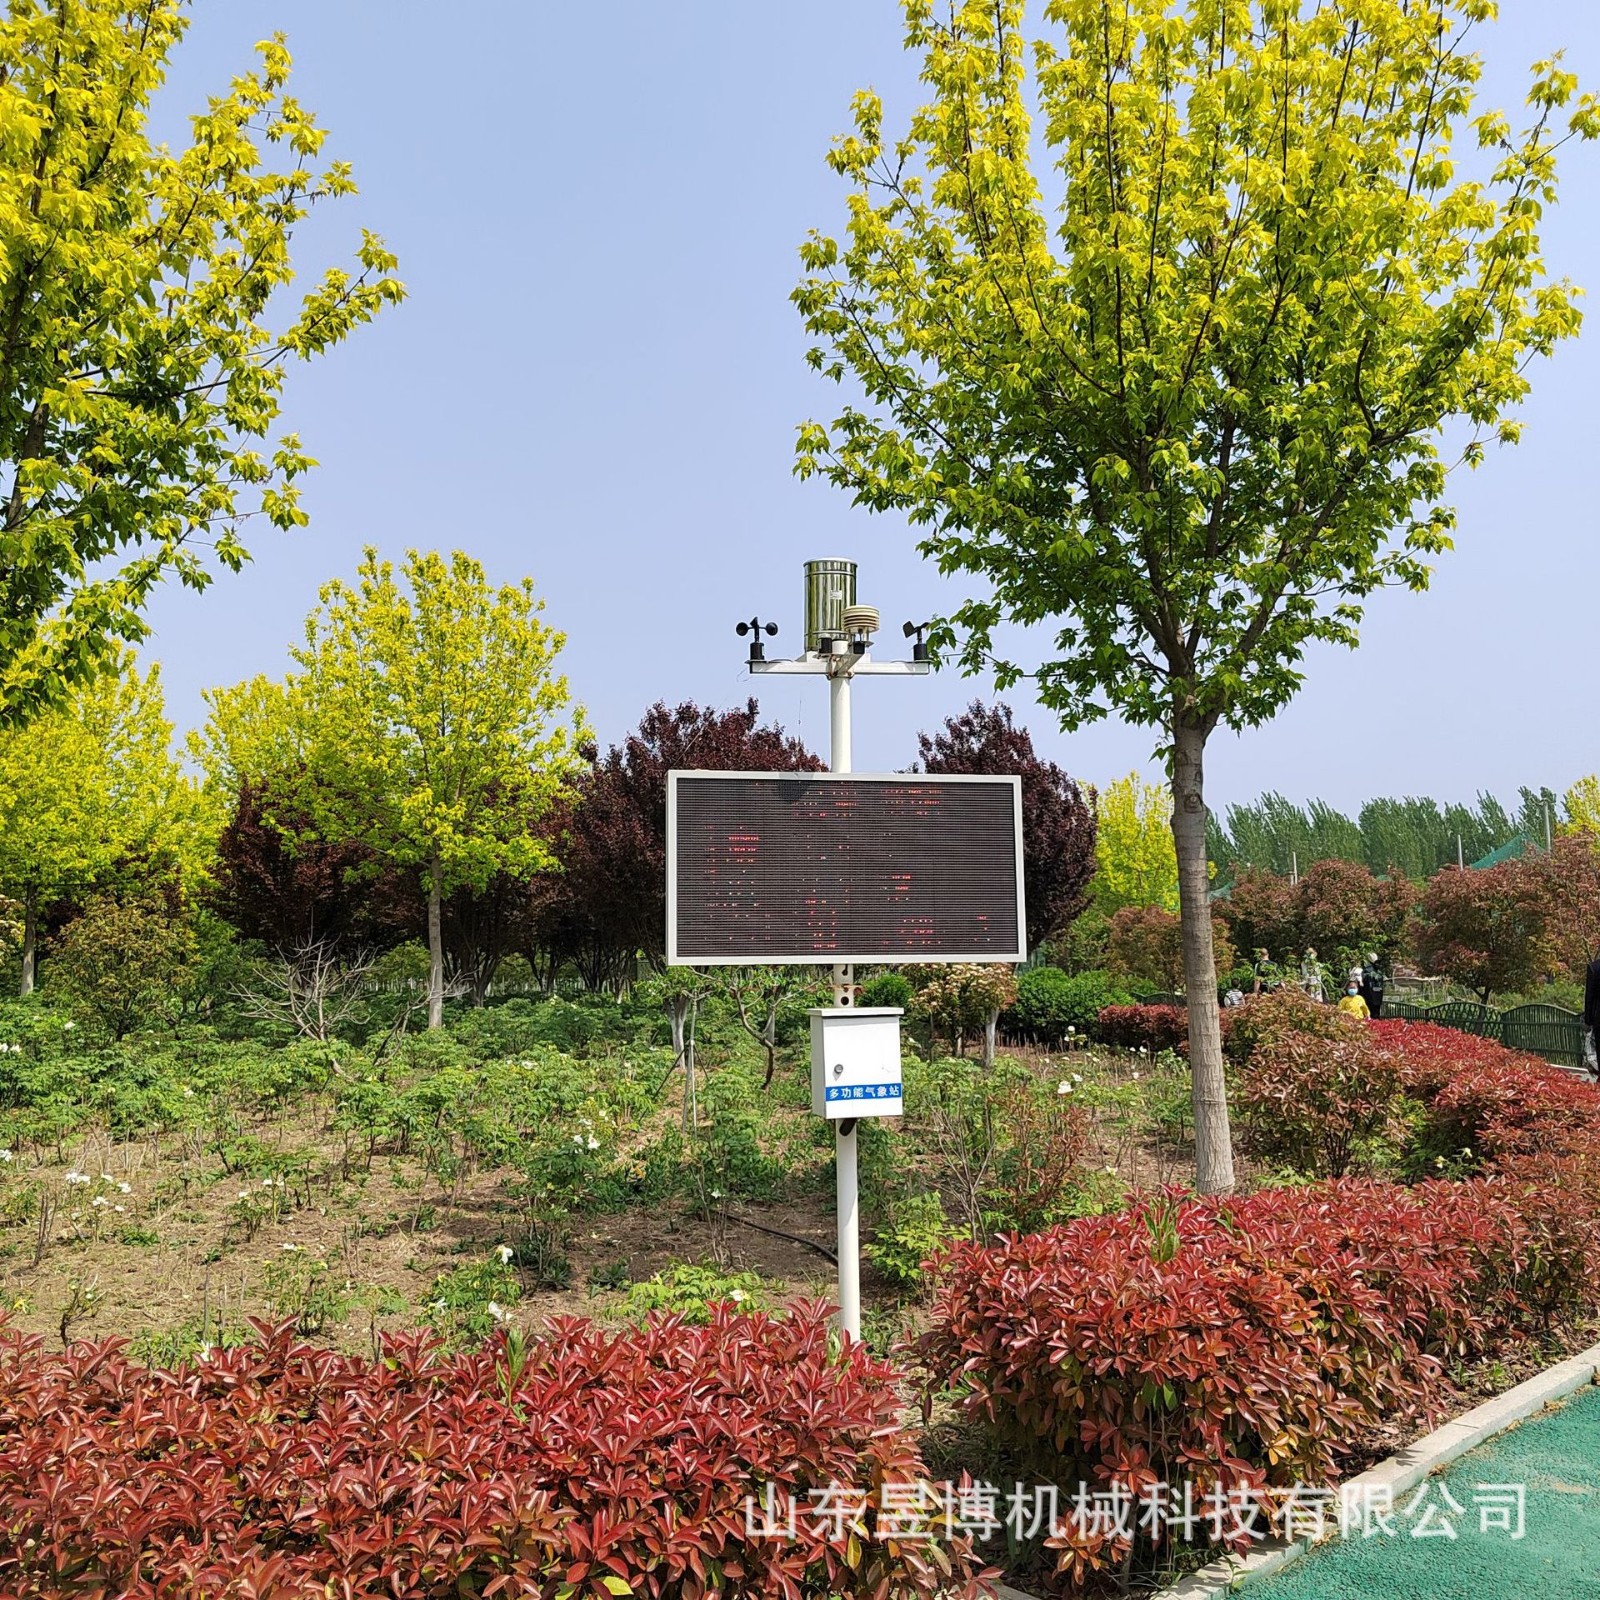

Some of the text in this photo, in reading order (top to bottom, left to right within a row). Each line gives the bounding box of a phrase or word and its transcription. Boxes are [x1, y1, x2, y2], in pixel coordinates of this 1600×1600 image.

[830, 1086, 899, 1098] 多功能气象站
